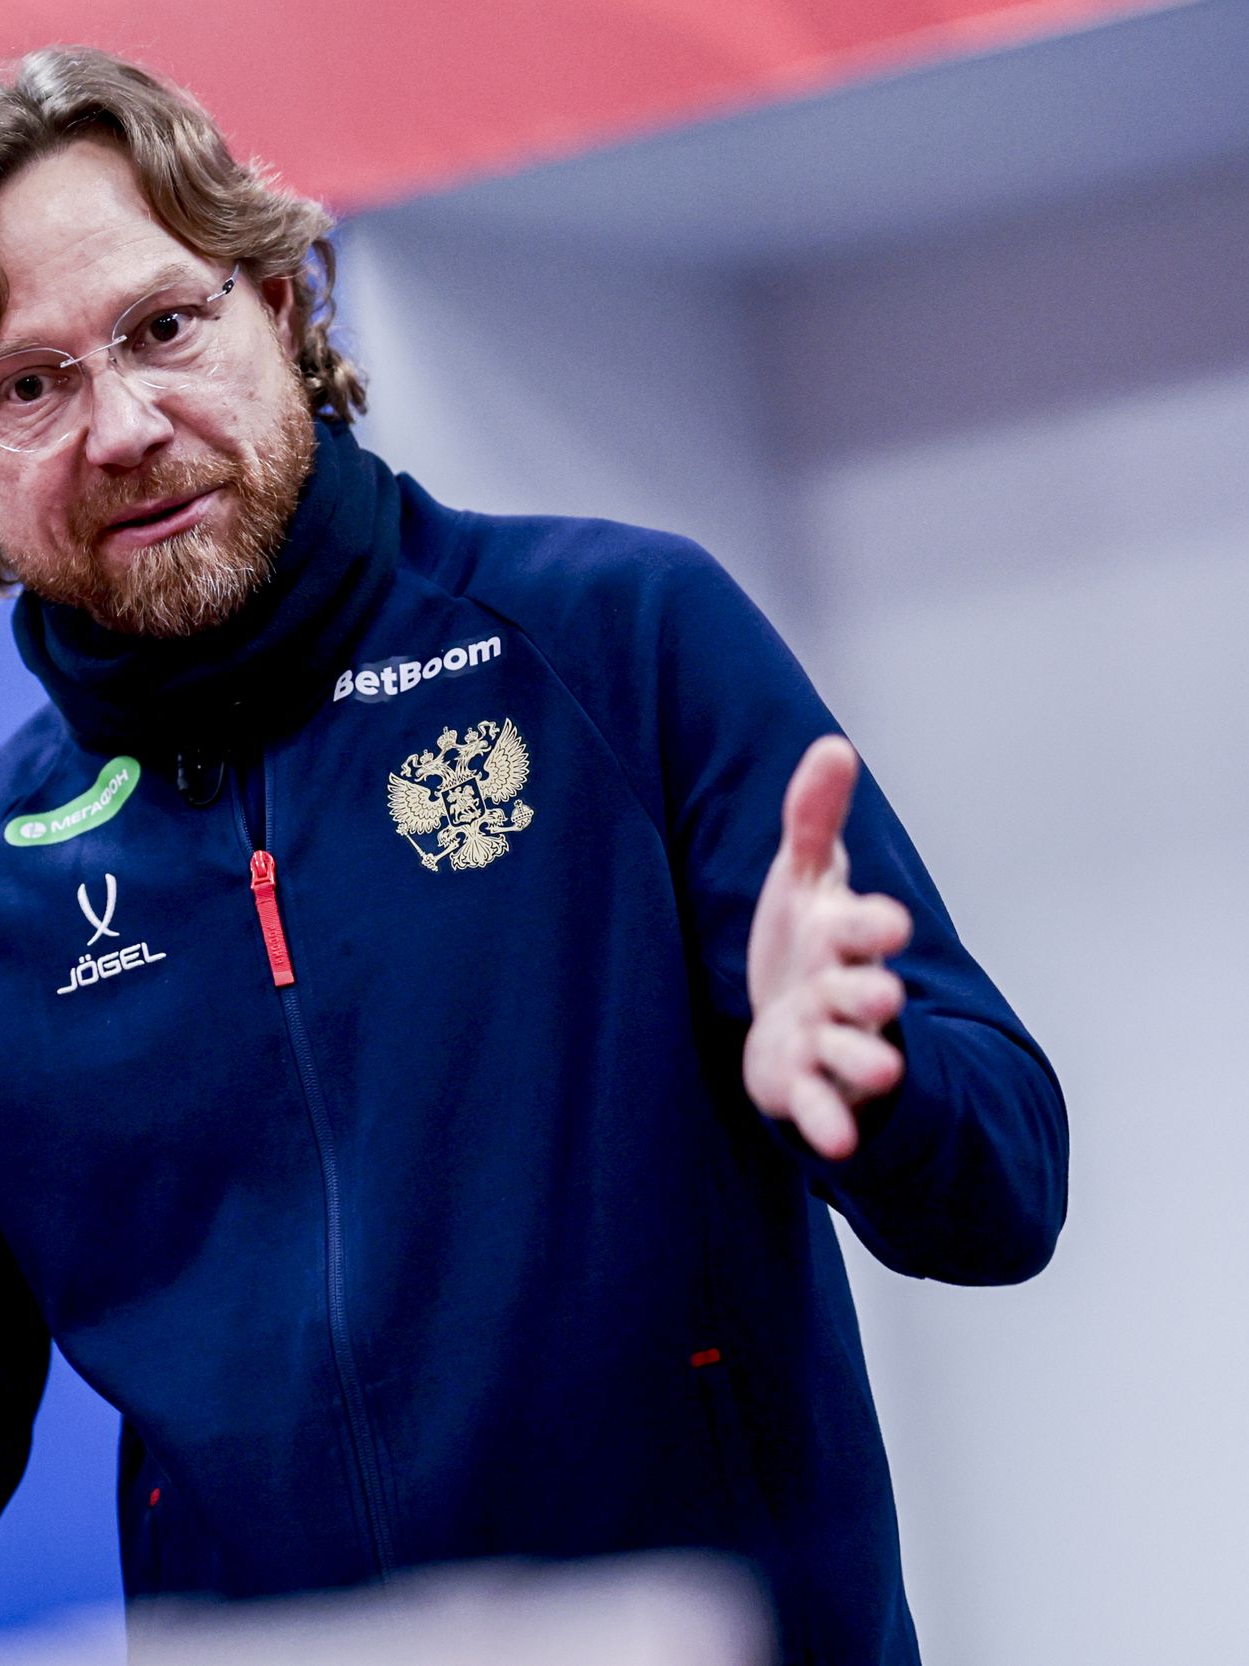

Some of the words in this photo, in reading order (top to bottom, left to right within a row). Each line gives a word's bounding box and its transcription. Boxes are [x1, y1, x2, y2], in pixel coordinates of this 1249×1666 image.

[333, 636, 501, 702] BetBoom
[51, 769, 129, 833] МЕГАФОН
[56, 942, 167, 995] JÖGEL
